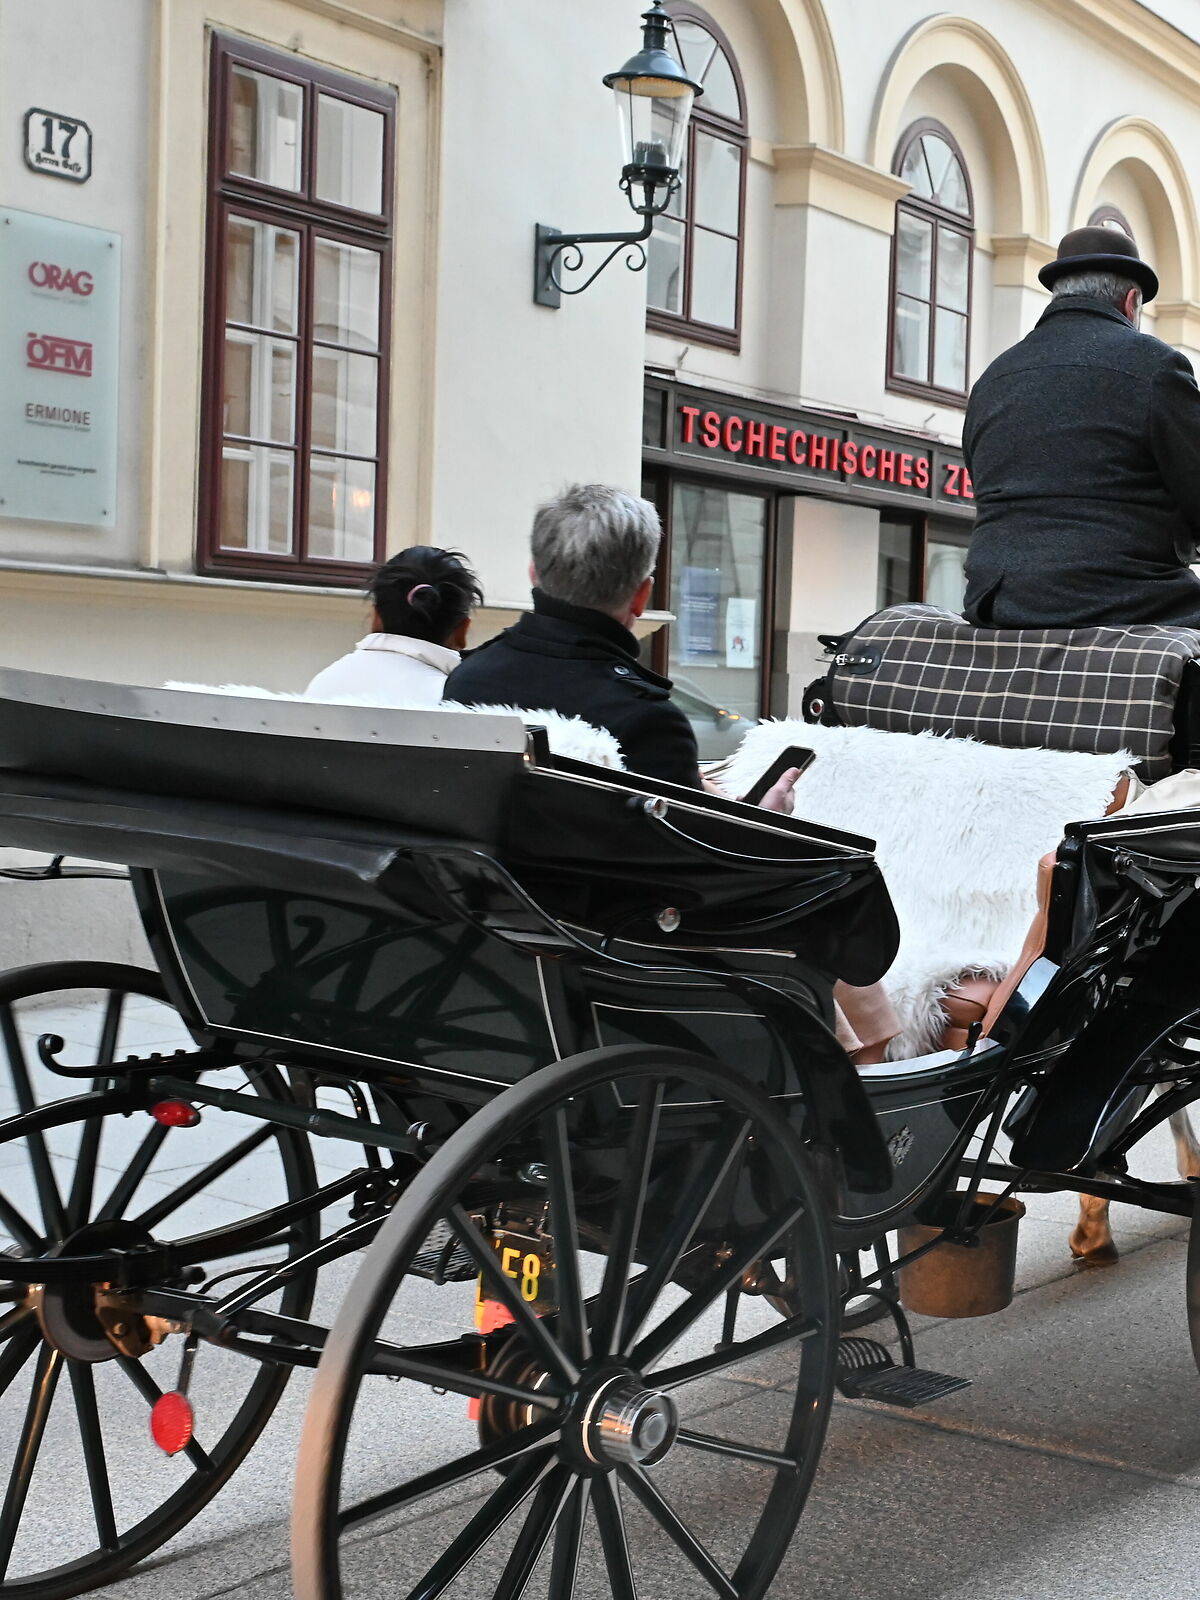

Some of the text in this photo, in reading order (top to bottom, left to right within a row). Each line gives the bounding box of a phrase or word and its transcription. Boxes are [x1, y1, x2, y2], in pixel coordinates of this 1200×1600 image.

[42, 117, 78, 159] 17
[25, 402, 91, 426] ERMIONE
[679, 405, 930, 489] TSCHECHISCHES
